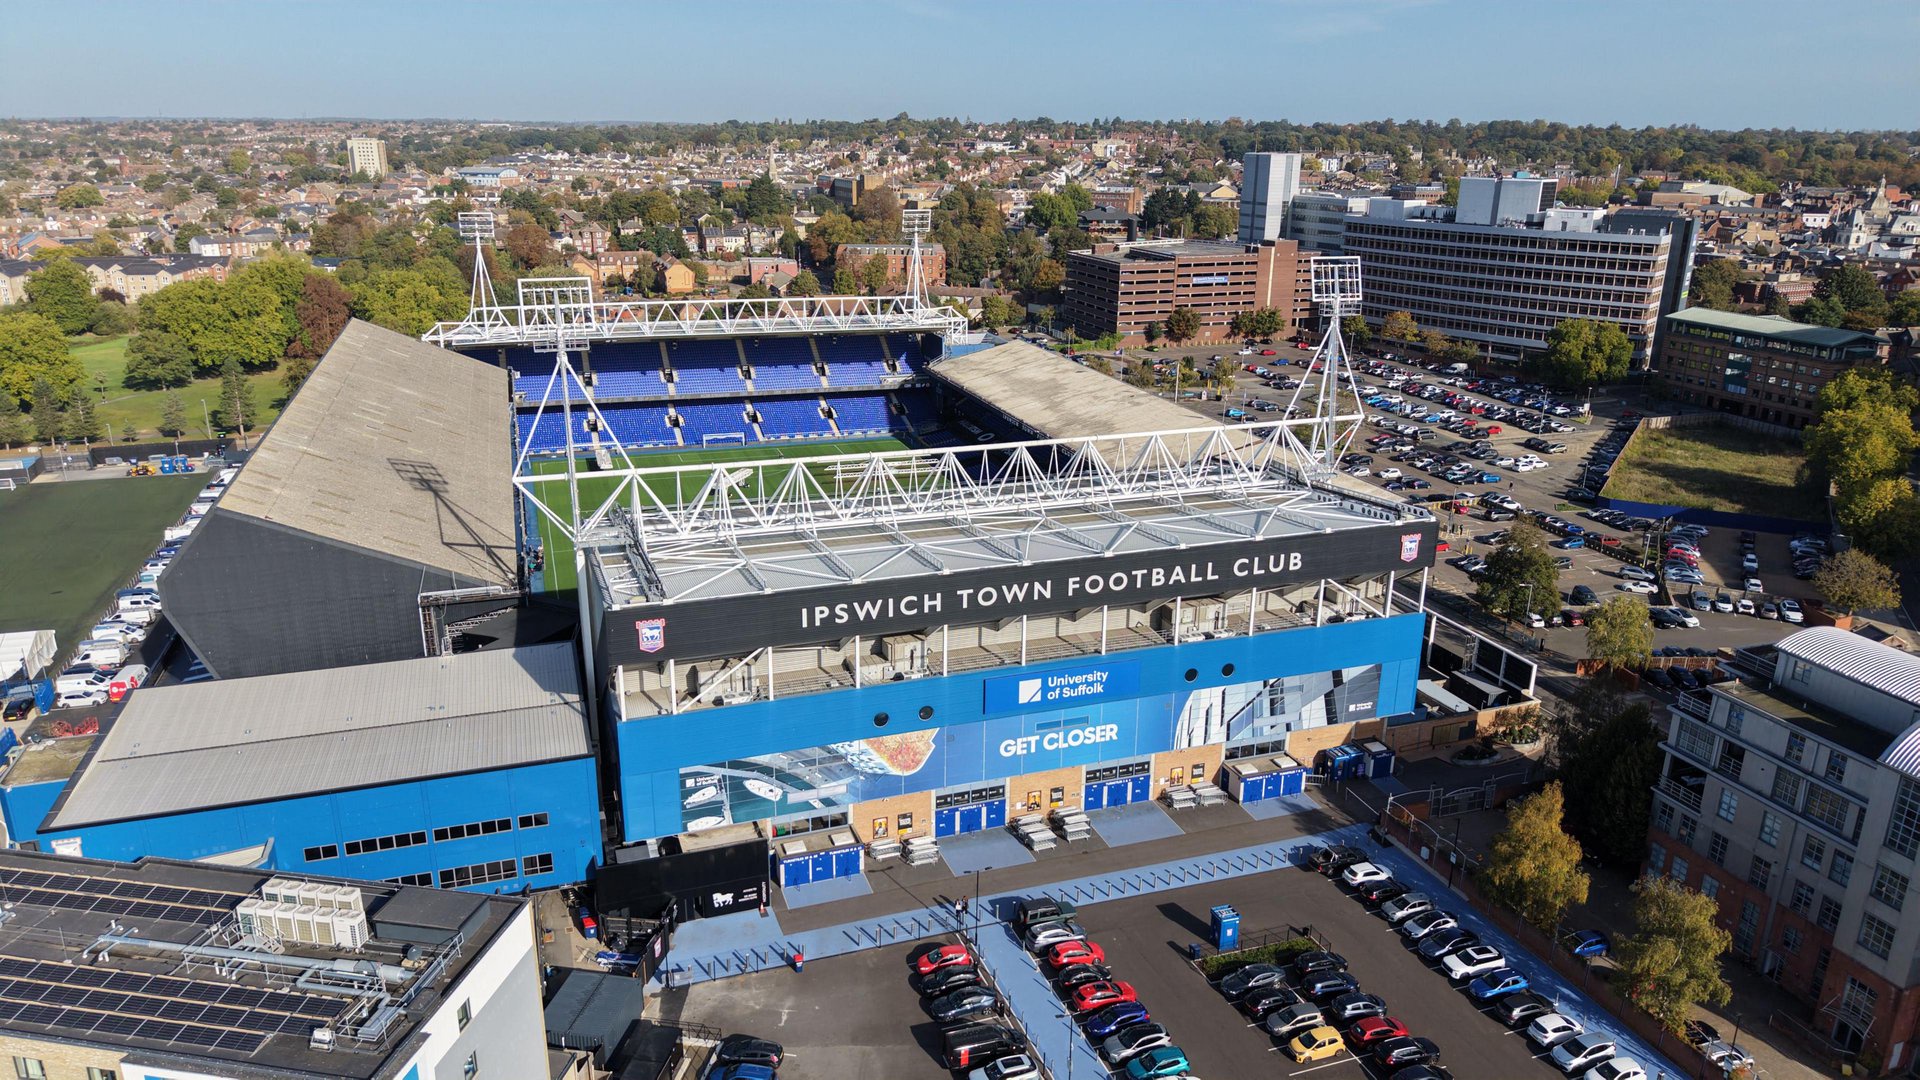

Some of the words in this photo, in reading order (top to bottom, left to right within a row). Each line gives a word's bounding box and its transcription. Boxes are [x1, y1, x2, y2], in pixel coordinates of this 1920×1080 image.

[801, 592, 942, 629] IPSWICH
[956, 579, 1052, 609] TOWN
[1067, 563, 1221, 597] FOOTBALL
[1233, 552, 1303, 577] CLUB
[1047, 671, 1109, 687] University
[1047, 686, 1061, 700] of
[1062, 682, 1104, 698] Suffolk
[999, 736, 1040, 757] GET
[1042, 723, 1119, 751] CLOSER
